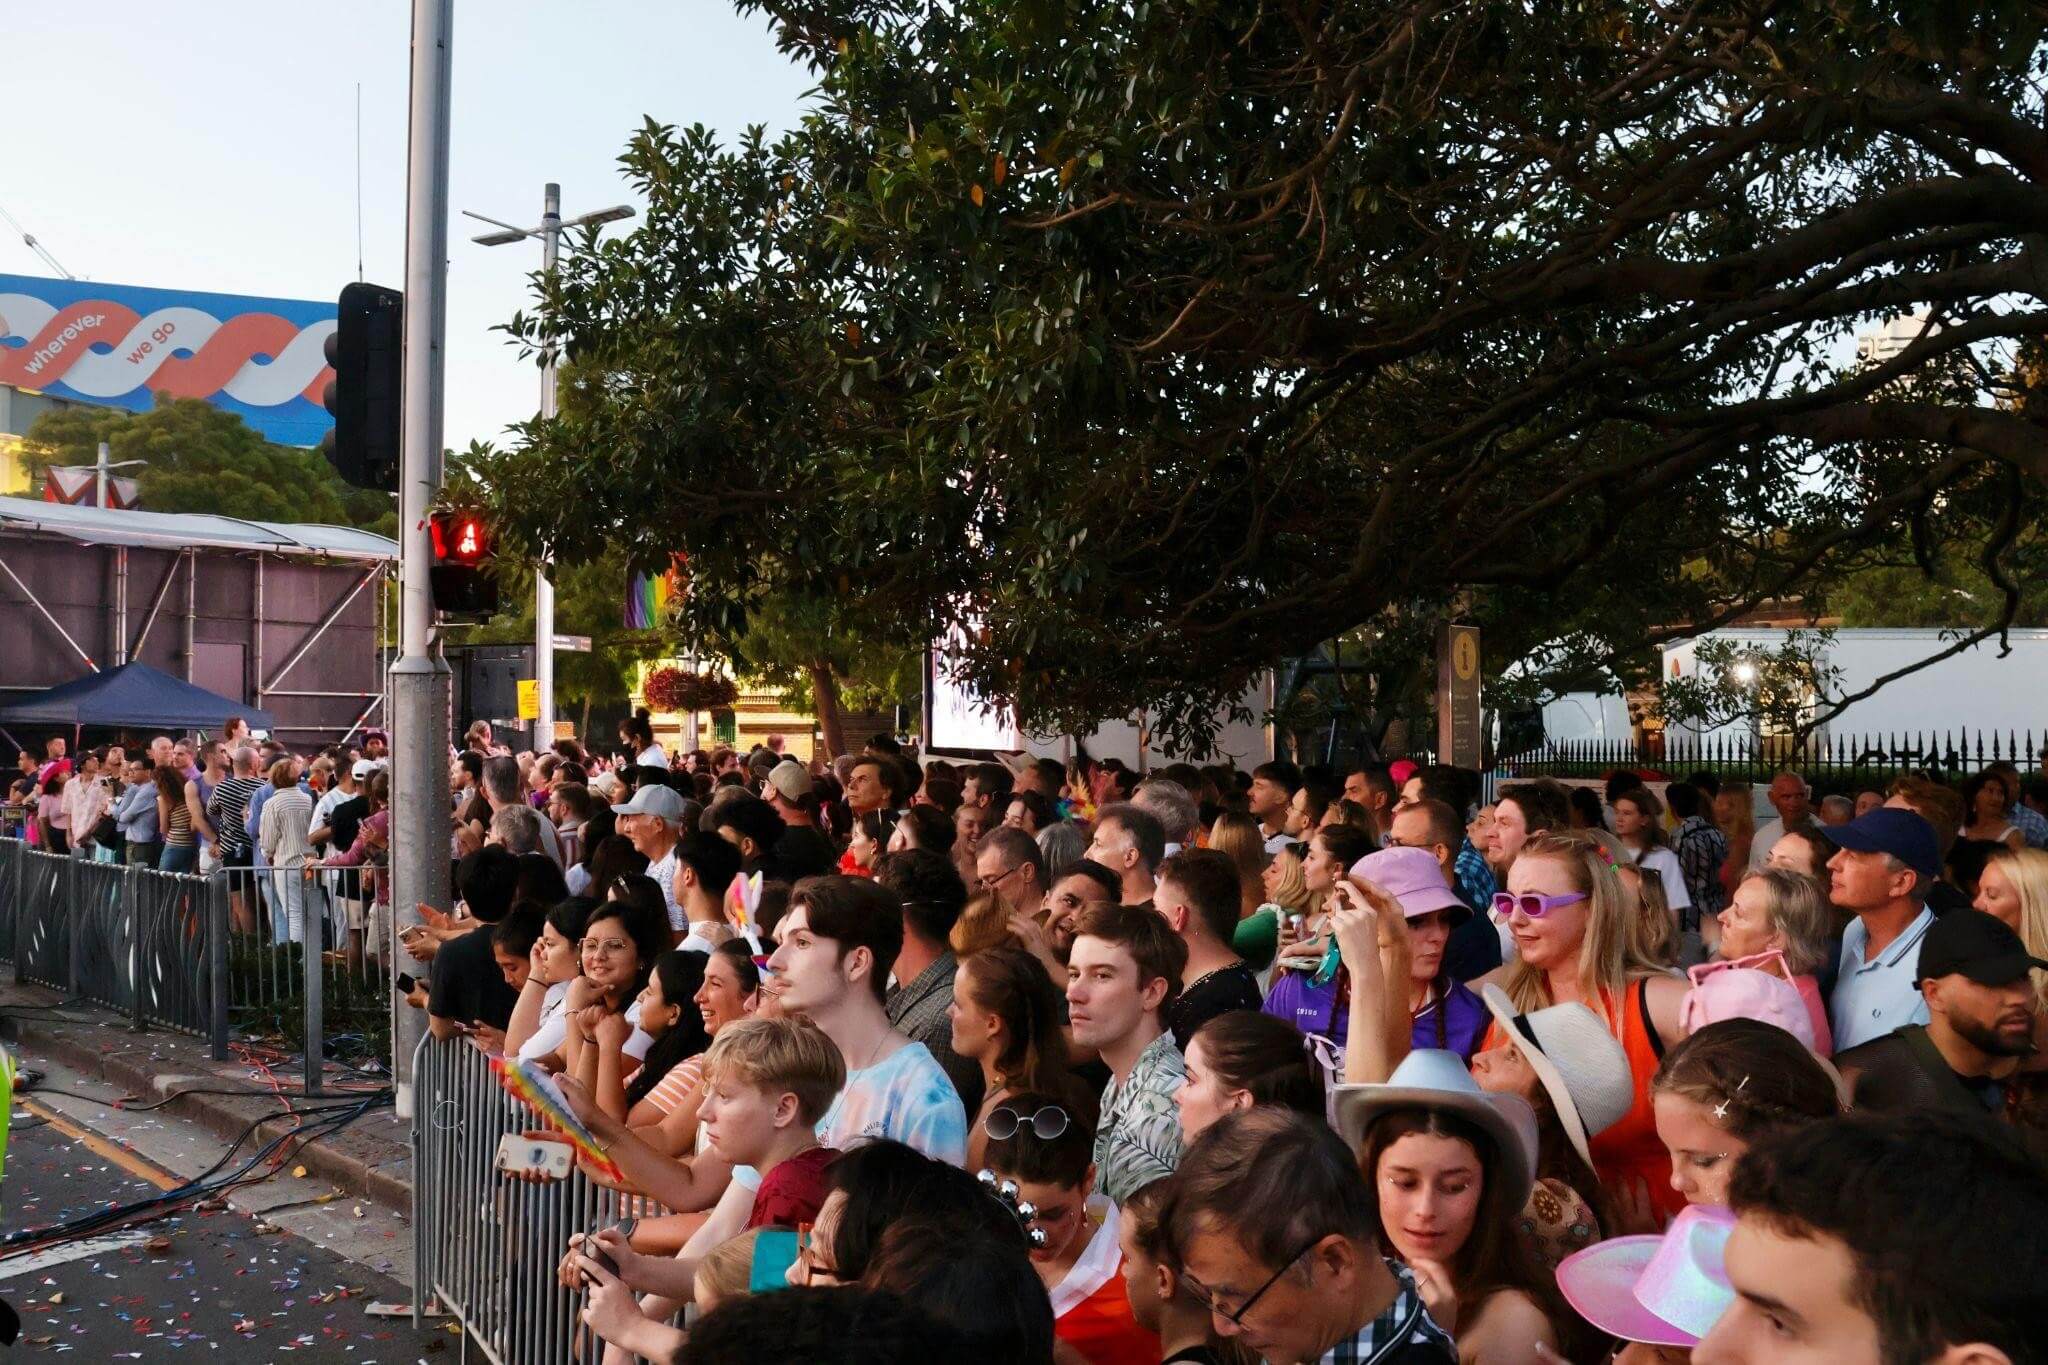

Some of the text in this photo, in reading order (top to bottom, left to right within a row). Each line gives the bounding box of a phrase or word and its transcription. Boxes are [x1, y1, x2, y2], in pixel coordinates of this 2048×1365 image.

[24, 313, 106, 375] wherever
[126, 322, 175, 365] we go
